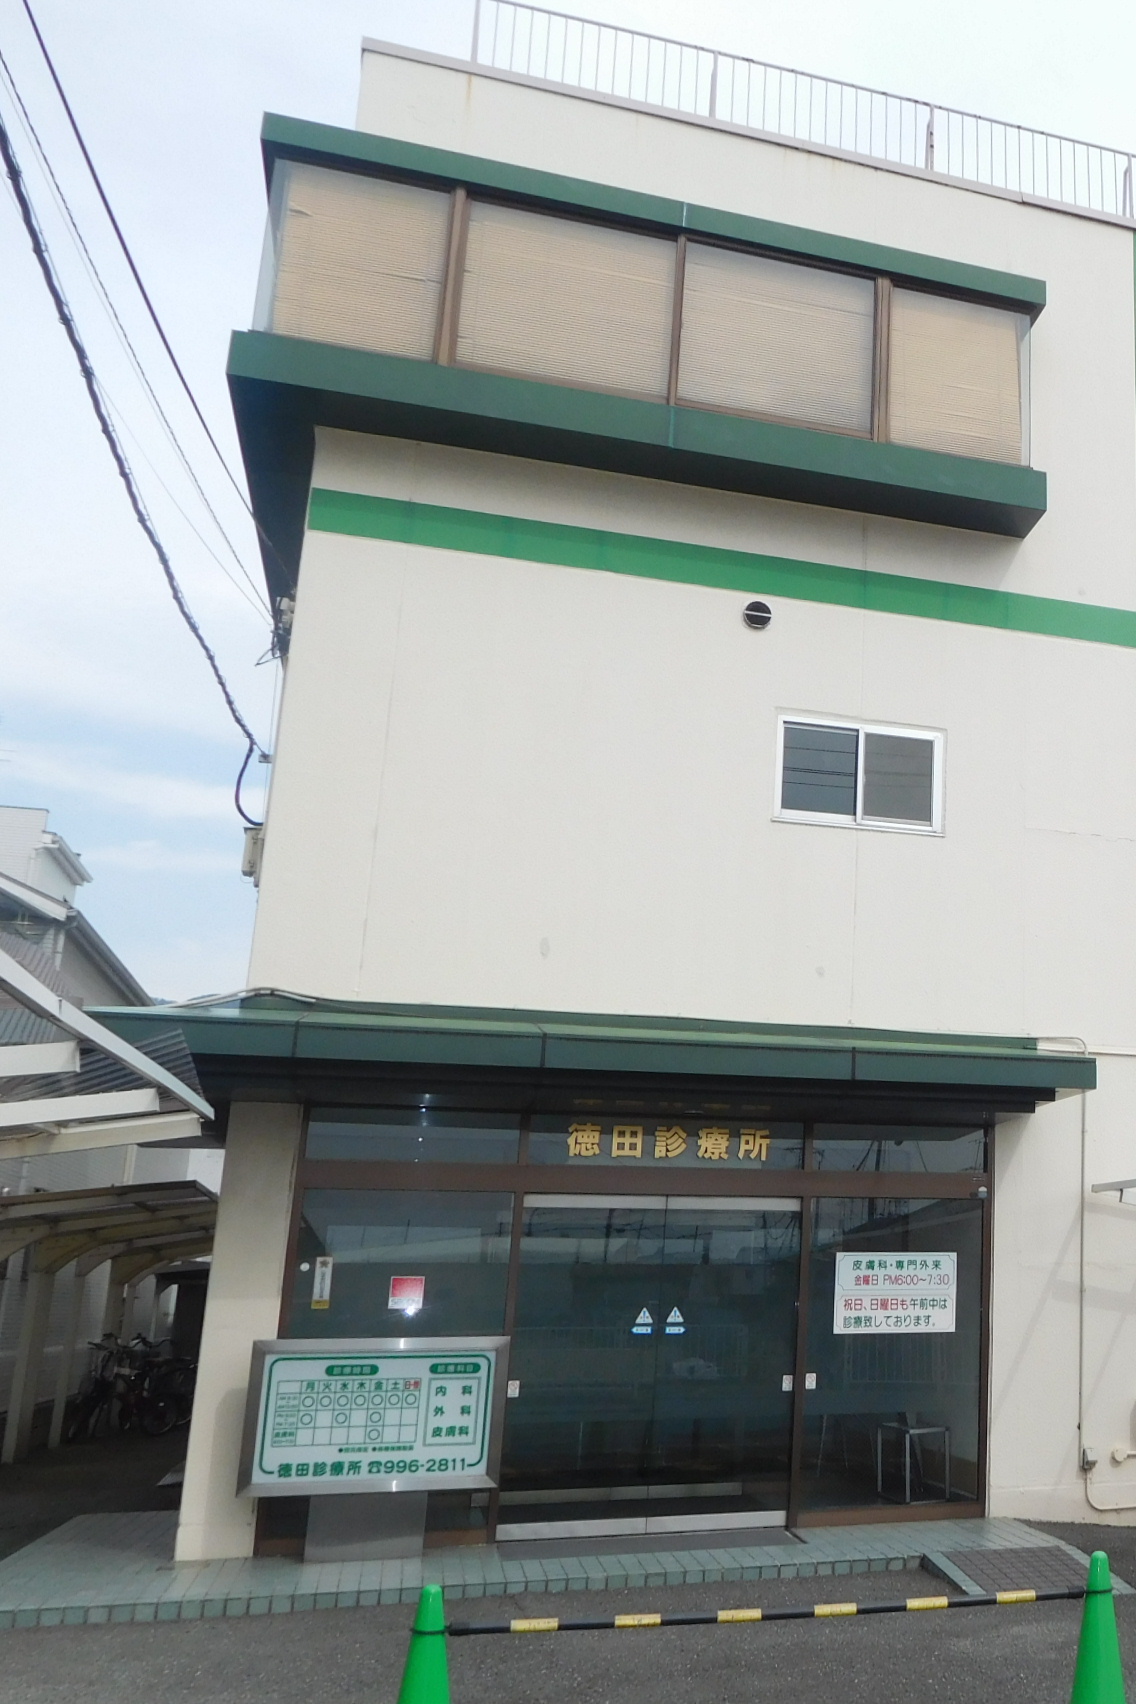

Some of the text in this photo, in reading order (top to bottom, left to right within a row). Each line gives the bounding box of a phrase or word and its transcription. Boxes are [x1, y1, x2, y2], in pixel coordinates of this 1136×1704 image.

[566, 1122, 771, 1161] 徳田診療所
[854, 1274, 879, 1286] 金曜日
[843, 1297, 948, 1311] 祝日、日曜日も午前中は
[842, 1314, 936, 1329] 診療致しております。
[306, 1382, 316, 1391] 月
[322, 1382, 332, 1391] 火
[340, 1381, 349, 1391] 水
[357, 1381, 366, 1390] 木
[374, 1381, 384, 1390] 金
[391, 1381, 400, 1390] 土
[435, 1385, 472, 1397] 内科
[433, 1405, 471, 1417] 外科
[431, 1425, 470, 1438] 皮膚科
[277, 1458, 466, 1478] 徳田診療所 996-2811
